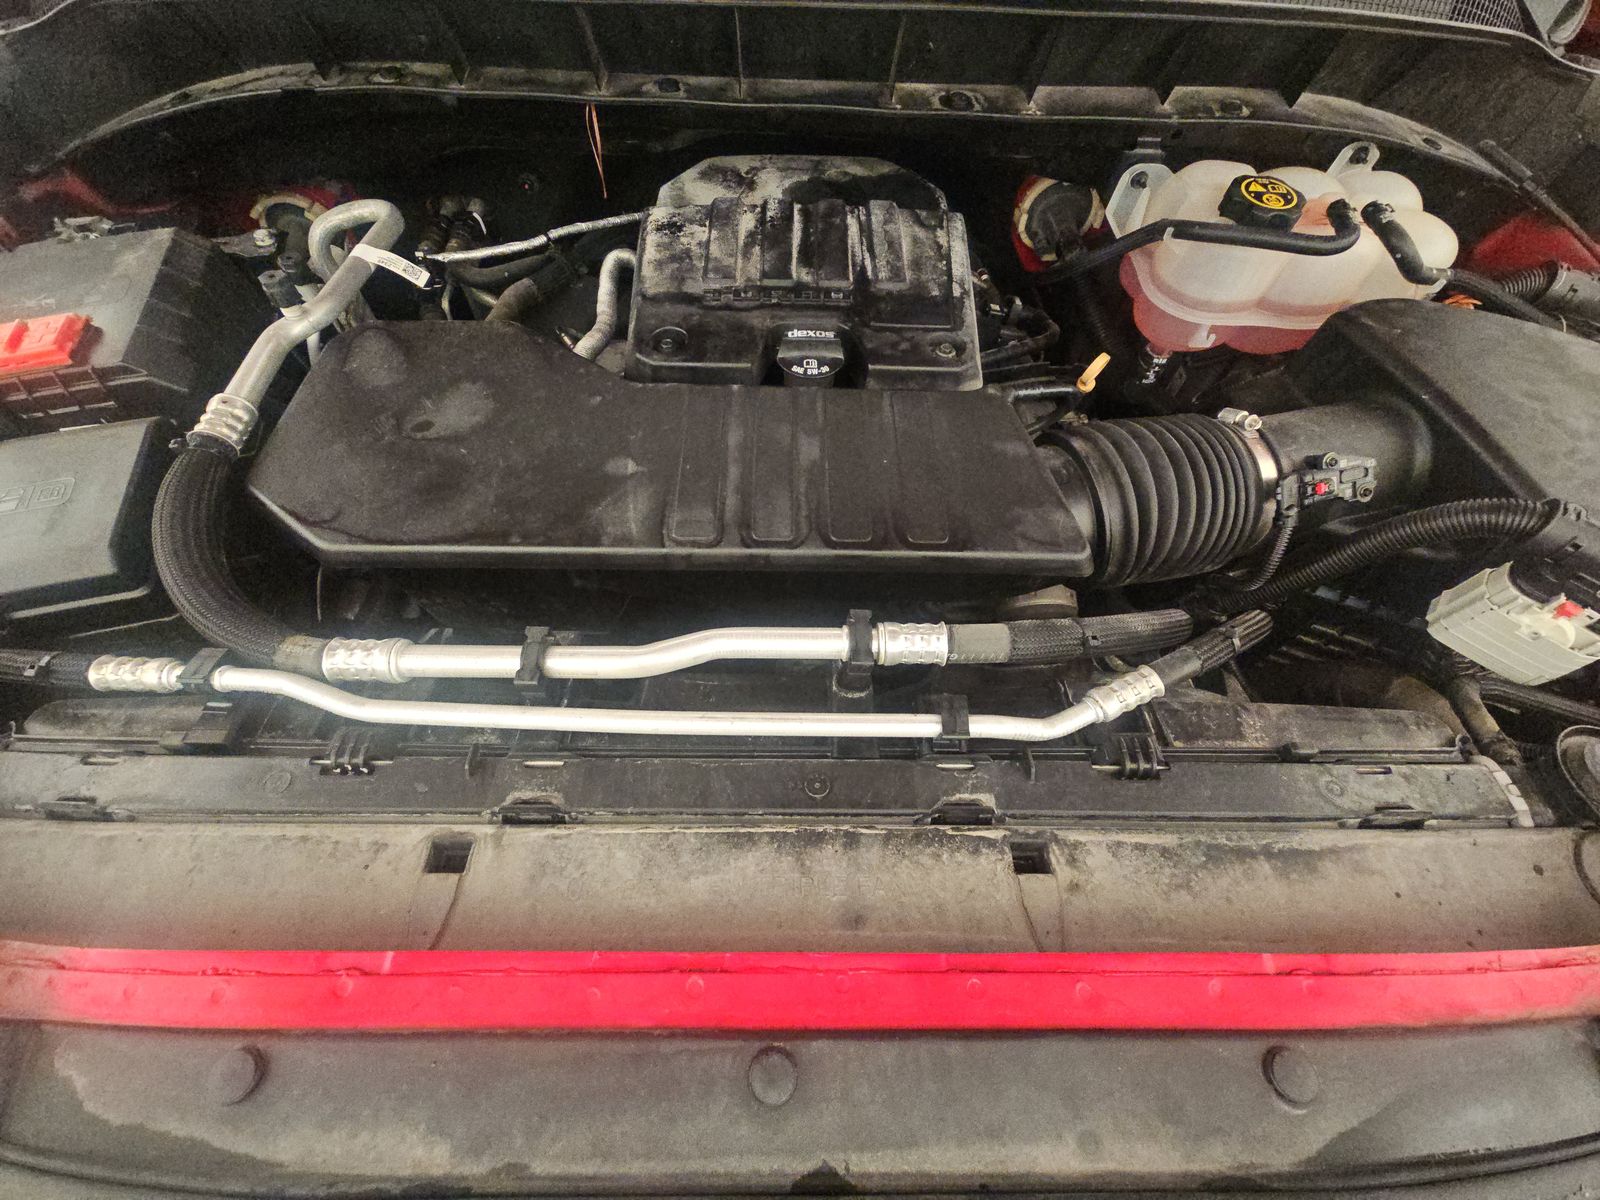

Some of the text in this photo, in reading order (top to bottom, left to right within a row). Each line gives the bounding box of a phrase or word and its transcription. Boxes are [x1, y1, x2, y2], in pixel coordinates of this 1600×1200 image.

[787, 329, 835, 338] dexos
[791, 365, 830, 375] SAE 5W-30
